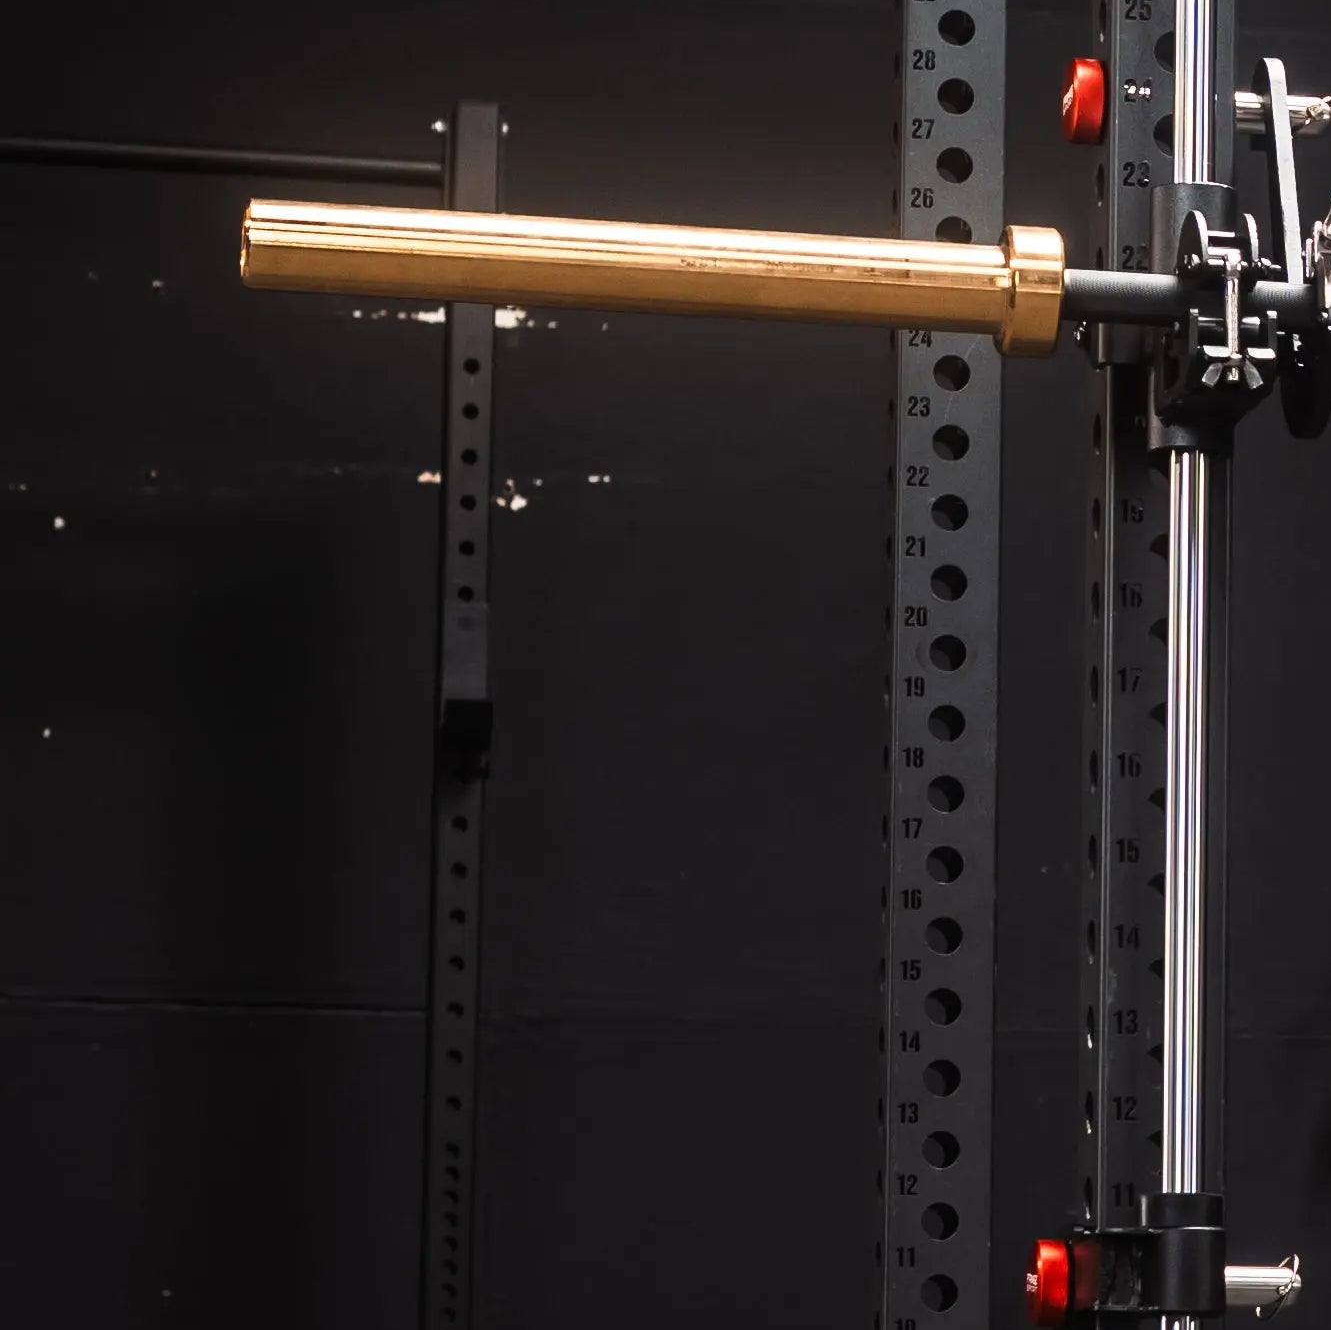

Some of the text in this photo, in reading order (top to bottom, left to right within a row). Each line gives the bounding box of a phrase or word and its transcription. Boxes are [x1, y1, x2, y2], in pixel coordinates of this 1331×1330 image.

[913, 50, 936, 71] 28
[912, 119, 934, 139] 27
[1123, 162, 1150, 187] 23
[911, 188, 933, 208] 26
[1122, 245, 1148, 270] 22
[908, 329, 932, 347] 24
[907, 397, 930, 417] 23
[907, 467, 929, 486] 22
[905, 537, 926, 556] 21
[904, 606, 927, 627] 20
[904, 677, 925, 697] 19
[1118, 668, 1142, 693] 17
[903, 748, 924, 767] 18
[902, 819, 922, 838] 17
[1116, 838, 1139, 863] 15
[901, 890, 921, 909] 16
[1115, 925, 1140, 949] 14
[900, 960, 921, 980] 15
[1114, 1010, 1138, 1034] 13
[899, 1032, 920, 1052] 14
[898, 1104, 918, 1124] 13
[1113, 1096, 1136, 1120] 12
[897, 1175, 918, 1195] 12
[1112, 1183, 1134, 1207] 11
[897, 1247, 915, 1267] 11
